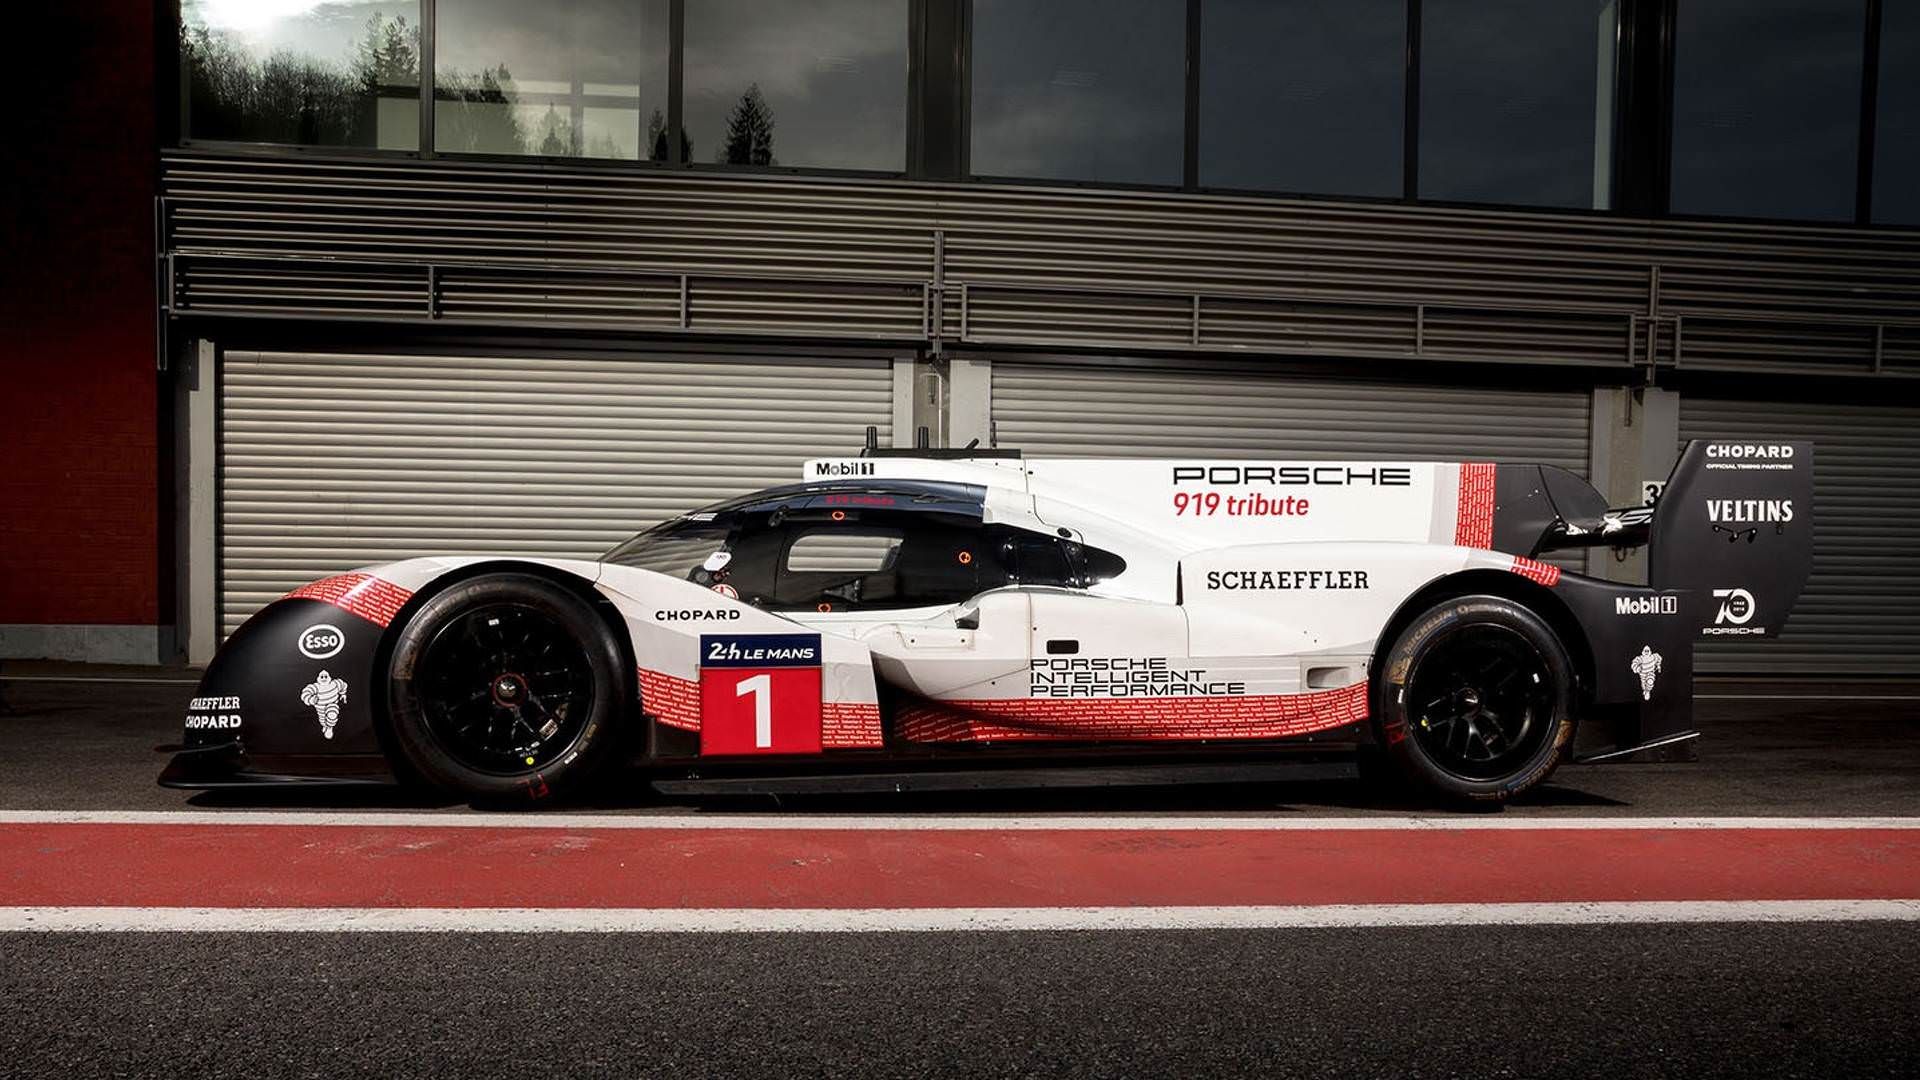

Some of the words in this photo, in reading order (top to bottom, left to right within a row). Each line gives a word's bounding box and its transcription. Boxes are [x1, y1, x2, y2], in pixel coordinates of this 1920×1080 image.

[1706, 444, 1794, 458] CHOPARD
[815, 463, 859, 476] Mobil
[1174, 467, 1411, 486] PORSCHE
[1173, 492, 1221, 517] 919
[1226, 491, 1310, 517] tribute
[1706, 499, 1793, 522] VELTINS
[1207, 571, 1369, 591] SCHAEFFLER
[1615, 596, 1660, 614] Mobil
[655, 610, 741, 621] CHOPARD
[1702, 627, 1766, 635] PORSCHE
[708, 642, 741, 660] 24h
[743, 649, 765, 660] LE
[766, 647, 814, 660] MANS
[1031, 657, 1167, 671] PORSCHE
[1031, 670, 1207, 684] INTELLIGENT
[1031, 682, 1246, 697] PERFORMANCE
[736, 674, 772, 748] 1
[185, 714, 242, 729] CHOPARD
